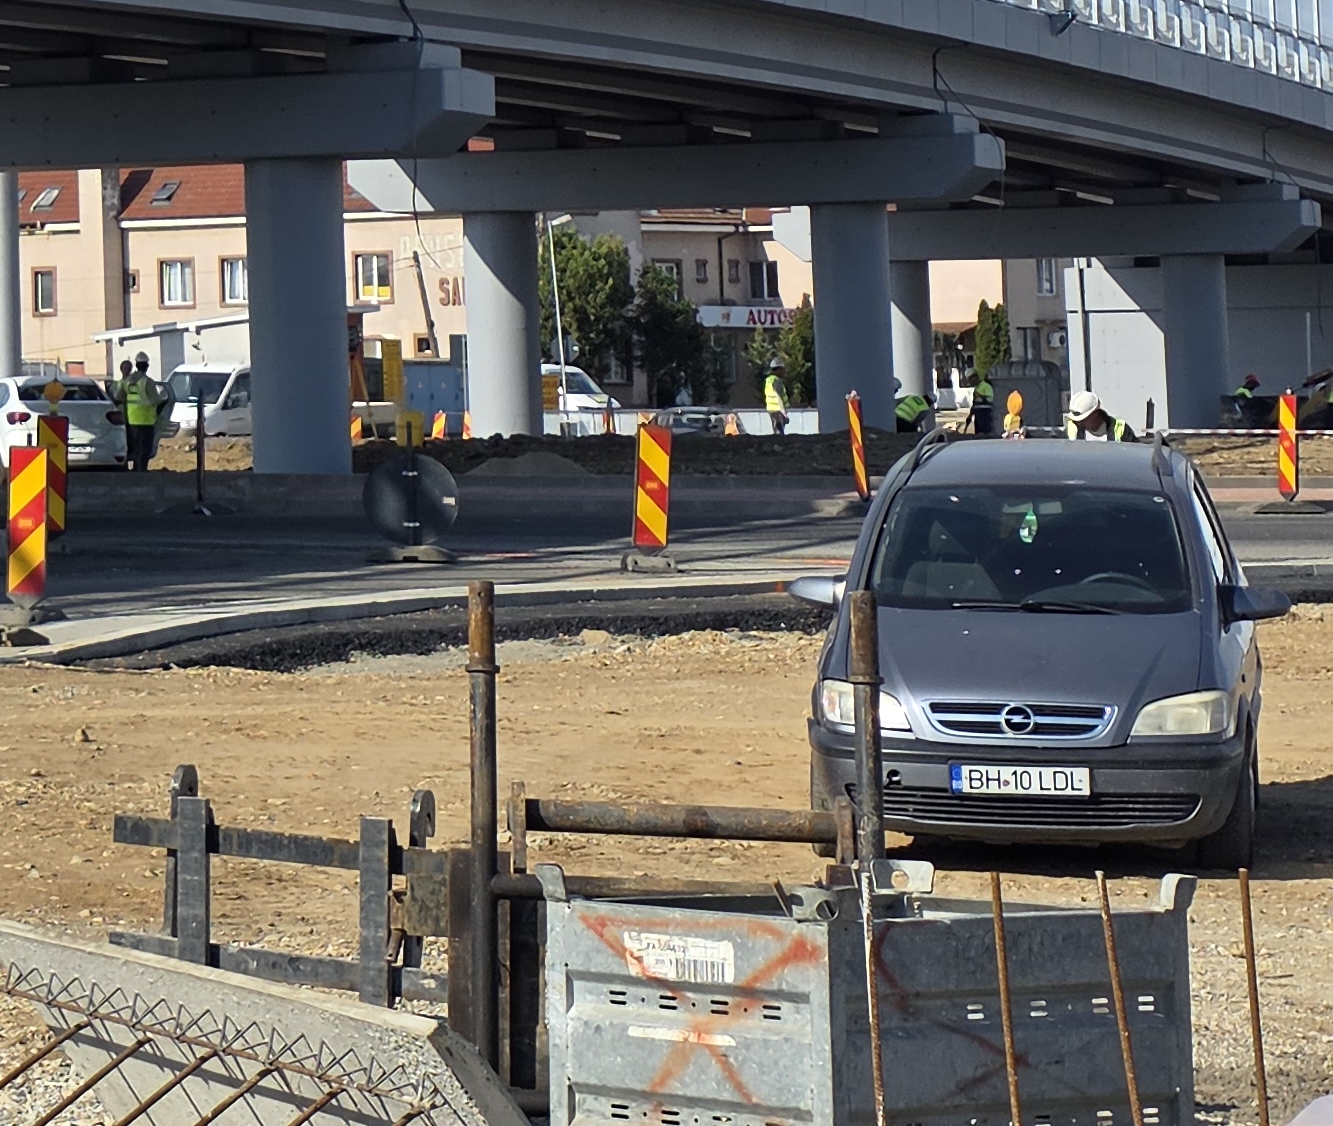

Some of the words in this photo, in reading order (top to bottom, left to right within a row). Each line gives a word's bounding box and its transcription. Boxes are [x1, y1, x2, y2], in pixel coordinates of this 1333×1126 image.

[438, 277, 465, 306] SA
[746, 309, 795, 325] AUTOS
[969, 769, 1002, 790] BH
[1011, 770, 1032, 791] 10
[1039, 770, 1084, 791] LDL
